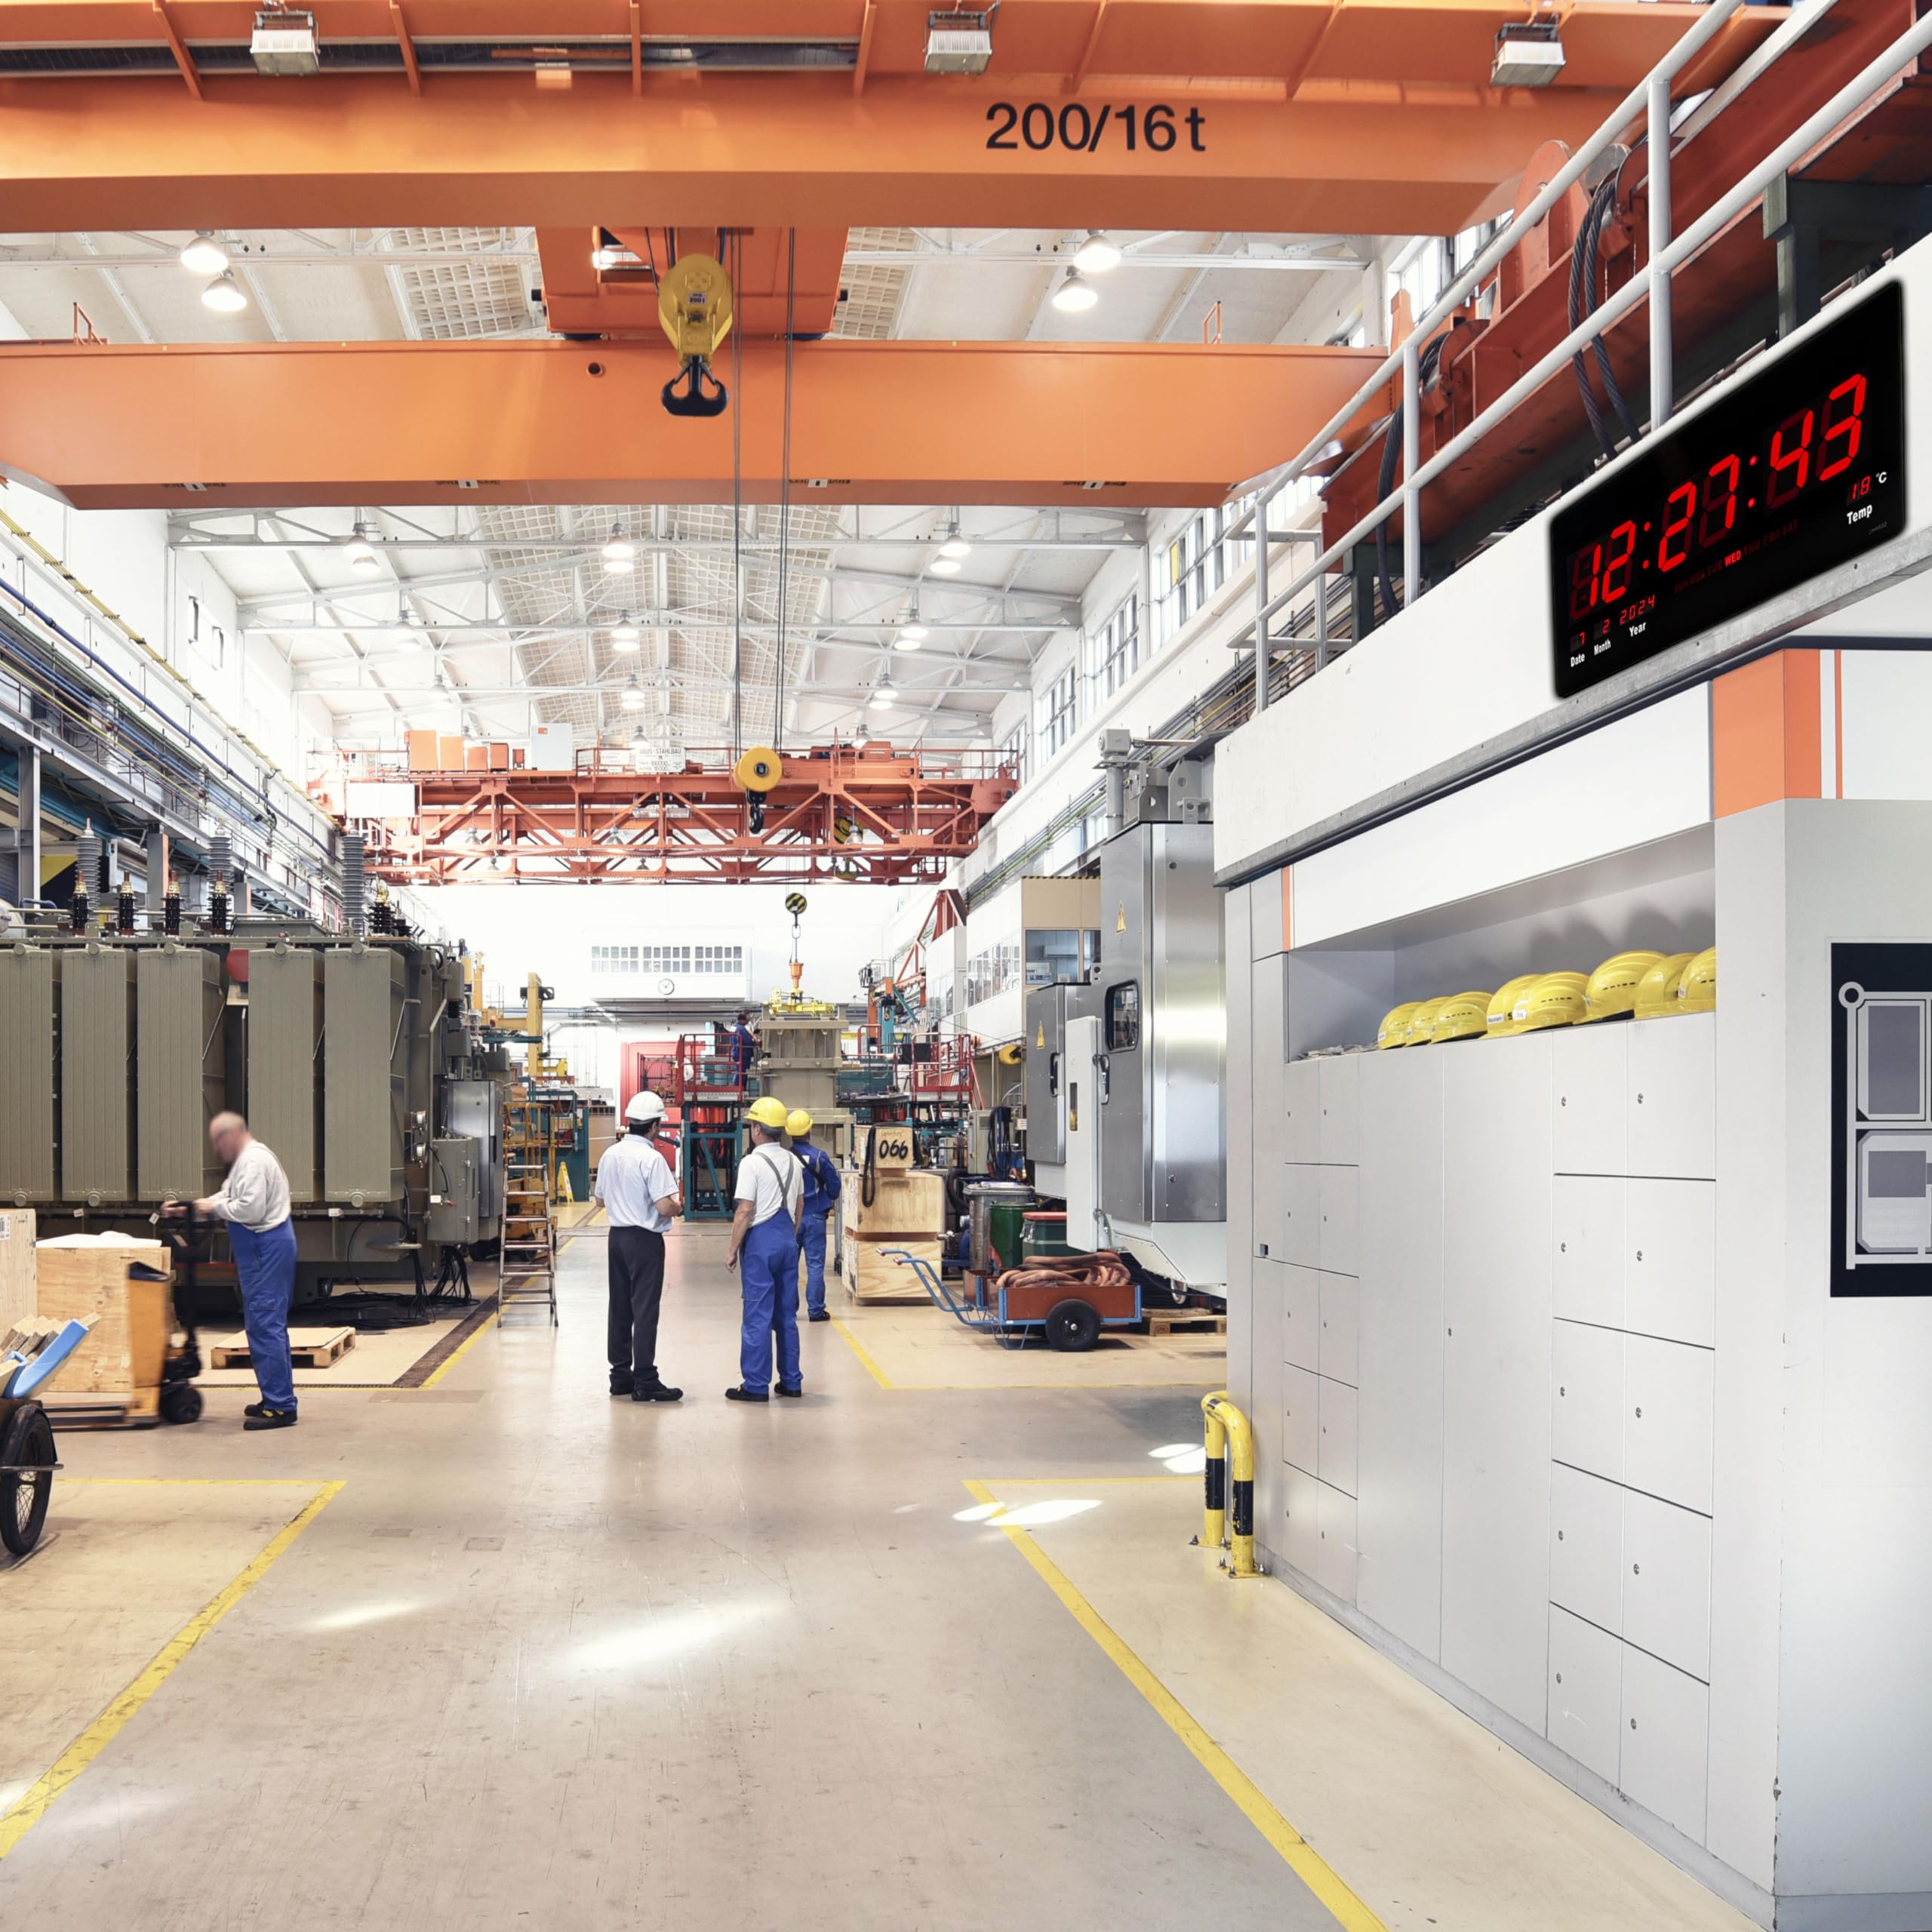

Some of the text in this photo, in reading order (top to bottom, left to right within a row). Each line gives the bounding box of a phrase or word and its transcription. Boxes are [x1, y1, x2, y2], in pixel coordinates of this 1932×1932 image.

[1589, 374, 1866, 608] 12:27:43
[1852, 475, 1871, 500] 18
[1846, 504, 1873, 525] Temp
[1724, 549, 1742, 568] WED
[1743, 540, 1761, 556] THU
[1763, 529, 1780, 546] FRI
[1782, 518, 1798, 537] SAT
[1579, 594, 1655, 645] 7 2 2024
[1570, 621, 1647, 668] Date Month Year
[879, 1140, 909, 1160] 066
